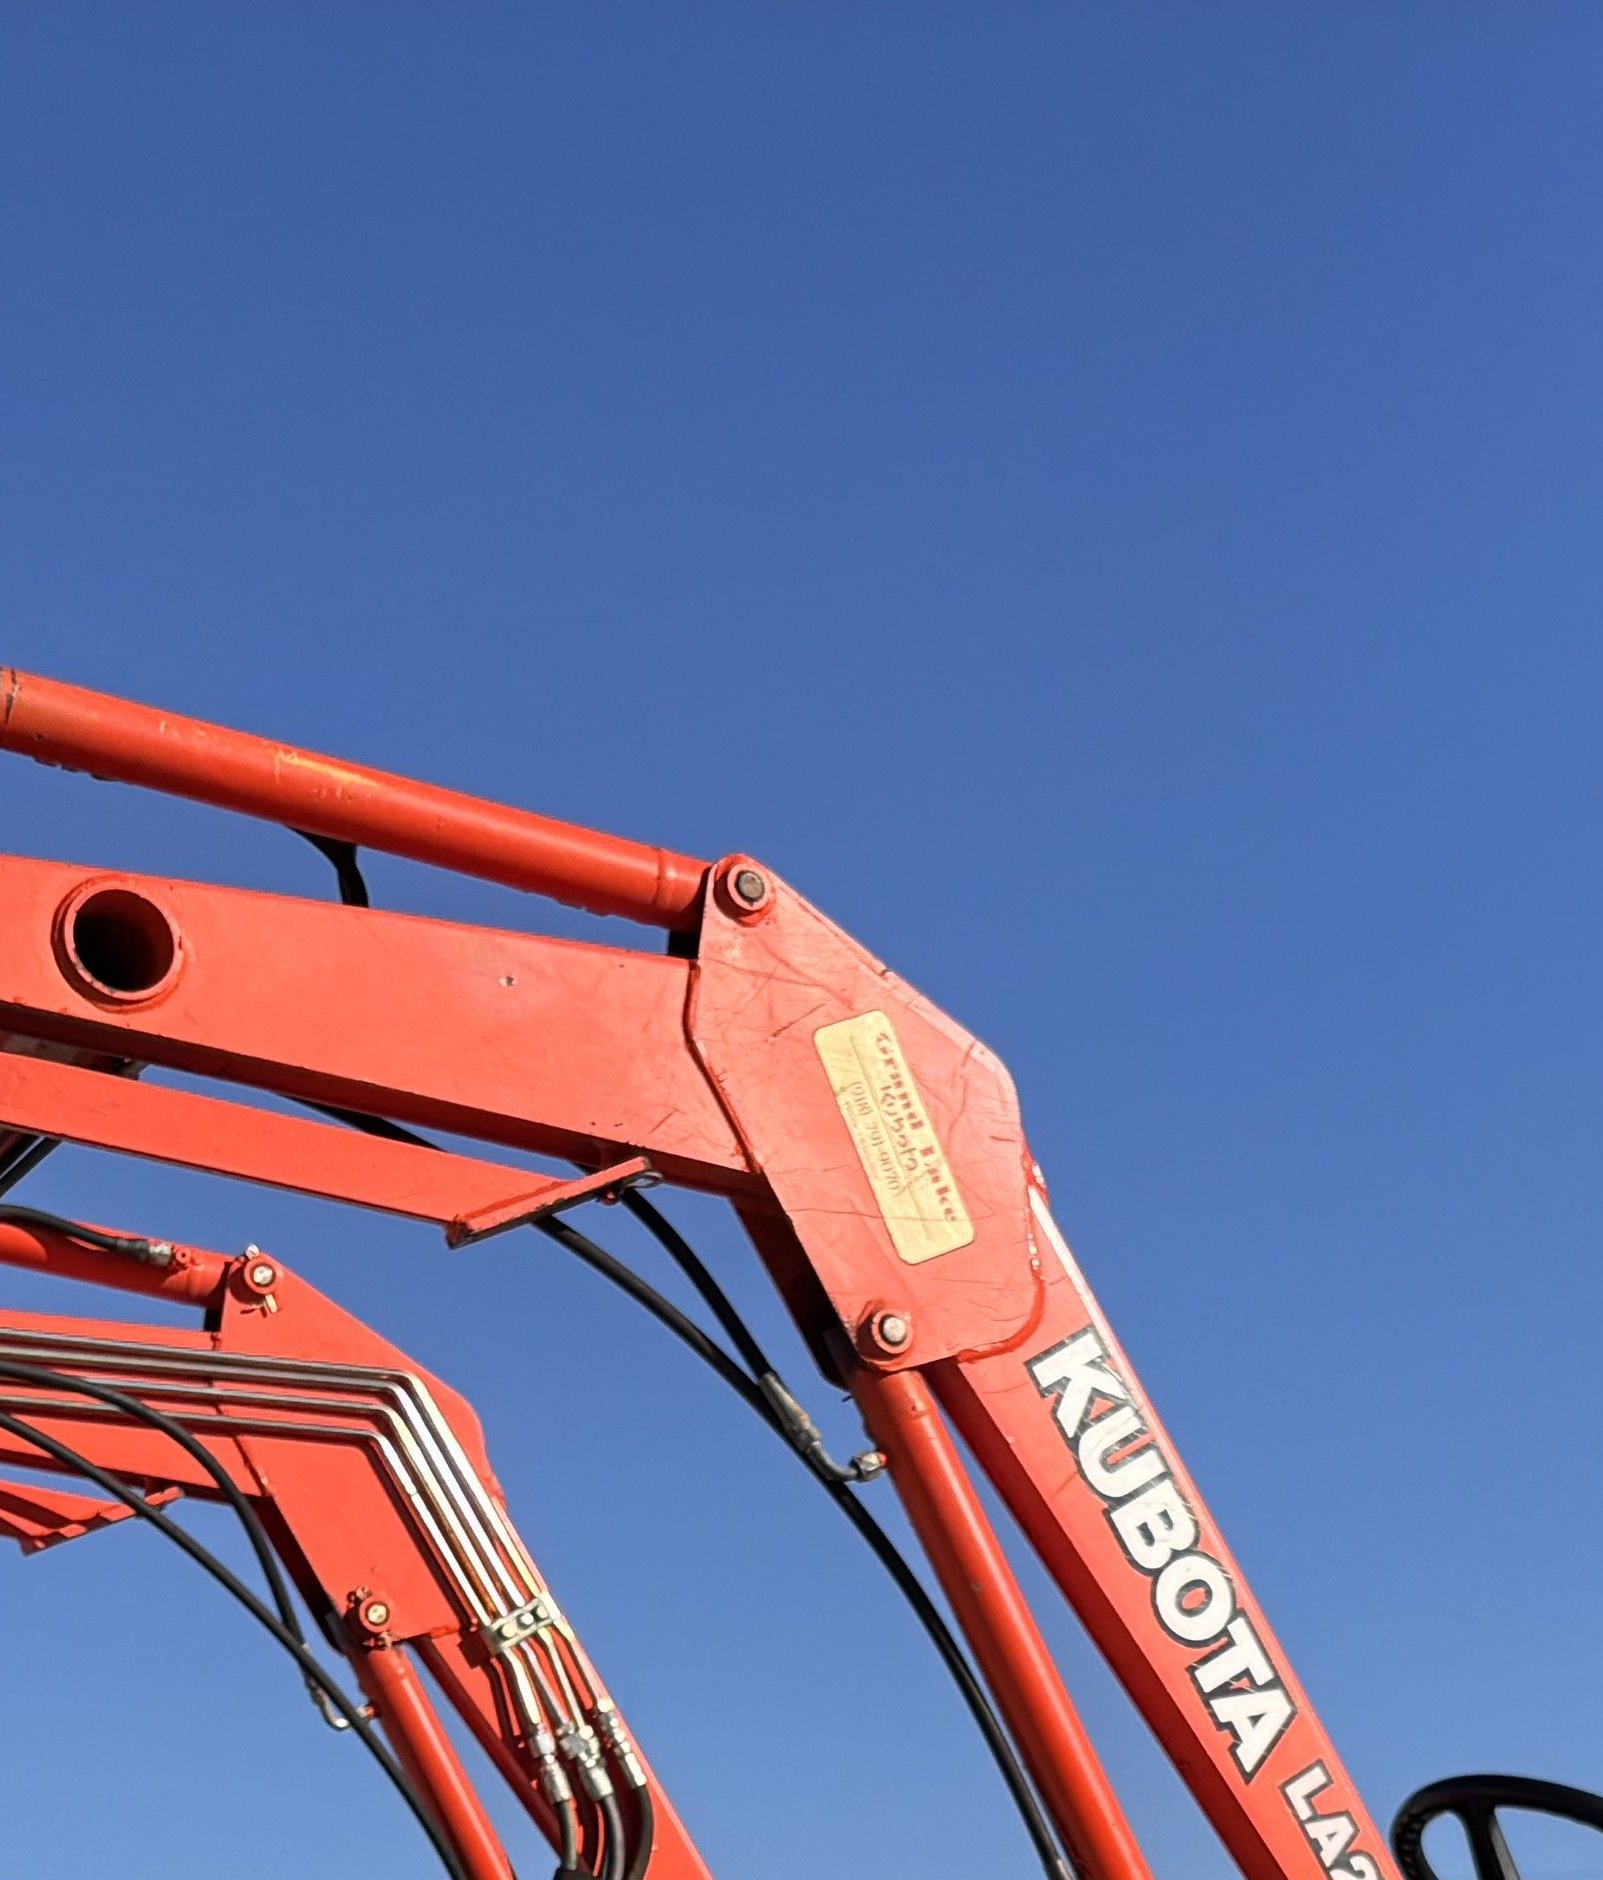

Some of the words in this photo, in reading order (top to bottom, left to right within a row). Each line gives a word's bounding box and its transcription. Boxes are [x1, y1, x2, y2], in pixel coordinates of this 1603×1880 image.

[875, 1032, 925, 1131] Grand
[880, 1084, 919, 1172] Kubota
[1030, 1329, 1295, 1779] KUBOTA
